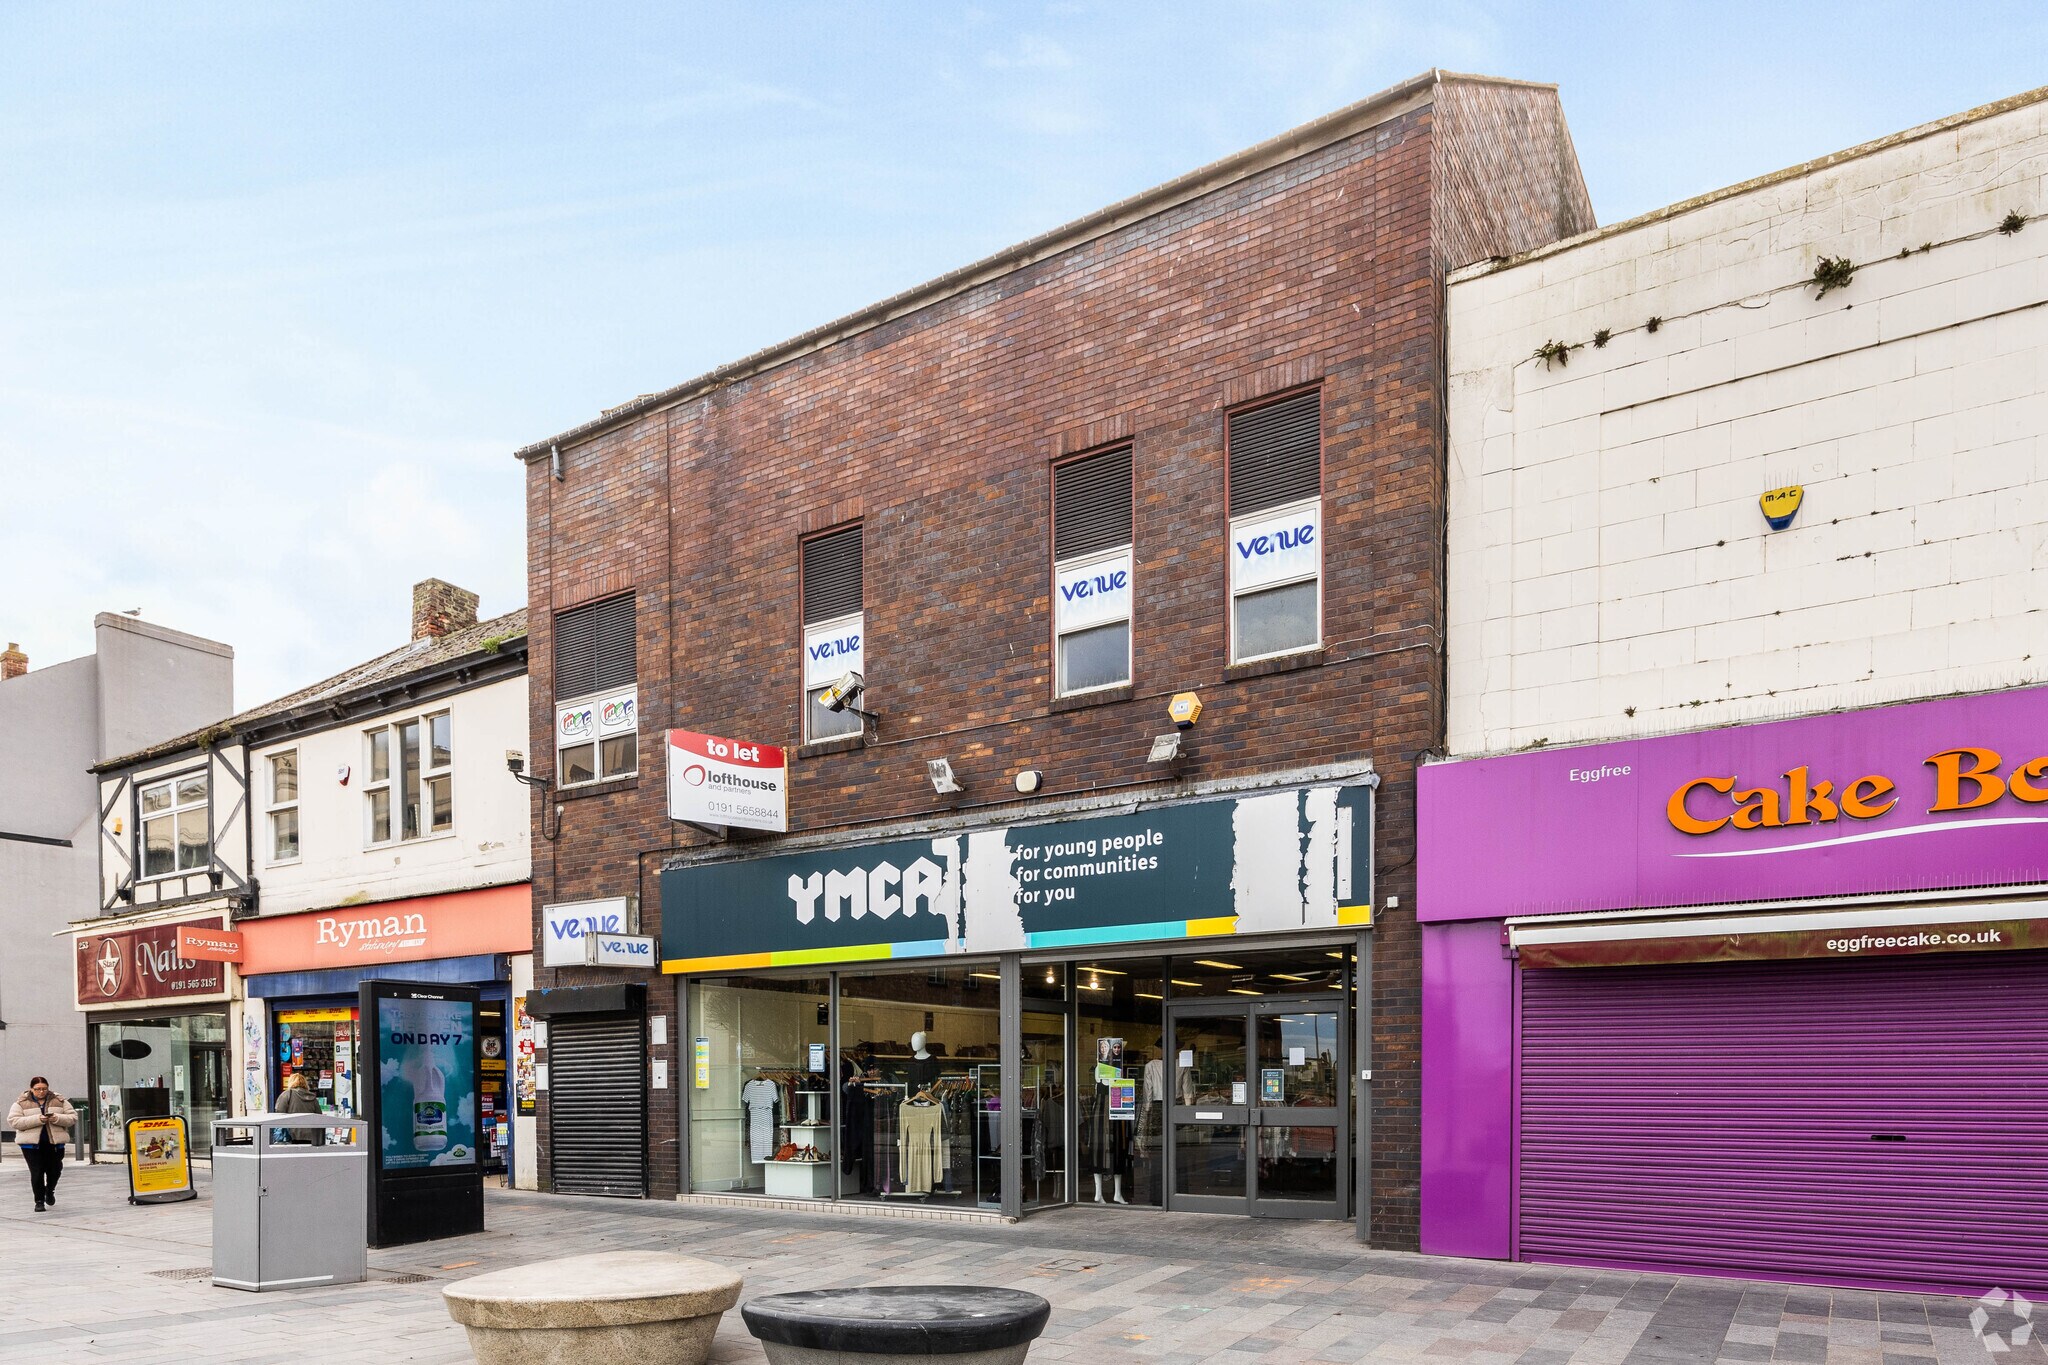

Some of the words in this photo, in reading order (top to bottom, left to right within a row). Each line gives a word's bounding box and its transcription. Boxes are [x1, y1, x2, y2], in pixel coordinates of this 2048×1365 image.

[1236, 524, 1314, 559] venue
[1061, 570, 1127, 602] venue
[809, 635, 860, 661] venue
[706, 738, 729, 758] to
[733, 742, 760, 762] let
[708, 770, 777, 792] lofthouse
[1569, 763, 1632, 783] Eggfree
[723, 785, 752, 796] partners
[1665, 764, 1900, 836] Cake
[708, 801, 733, 813] 0191
[736, 805, 779, 819] 5658844
[1016, 844, 1040, 861] for
[1044, 840, 1097, 862] young
[1102, 828, 1164, 855] people
[1016, 866, 1040, 882] for
[1044, 854, 1158, 881] communities
[787, 855, 943, 925] YMCA
[1016, 887, 1040, 904] for
[1044, 887, 1075, 906] you
[316, 913, 427, 948] Ryman
[1826, 929, 2002, 952] eggfreecake.co.uk
[185, 937, 239, 950] Ryman
[102, 960, 116, 969] Star
[171, 979, 186, 990] 0191
[187, 978, 199, 989] 565
[200, 977, 217, 988] 3187
[391, 1033, 415, 1045] ON
[418, 1033, 450, 1046] DAY
[453, 1034, 463, 1046] 7
